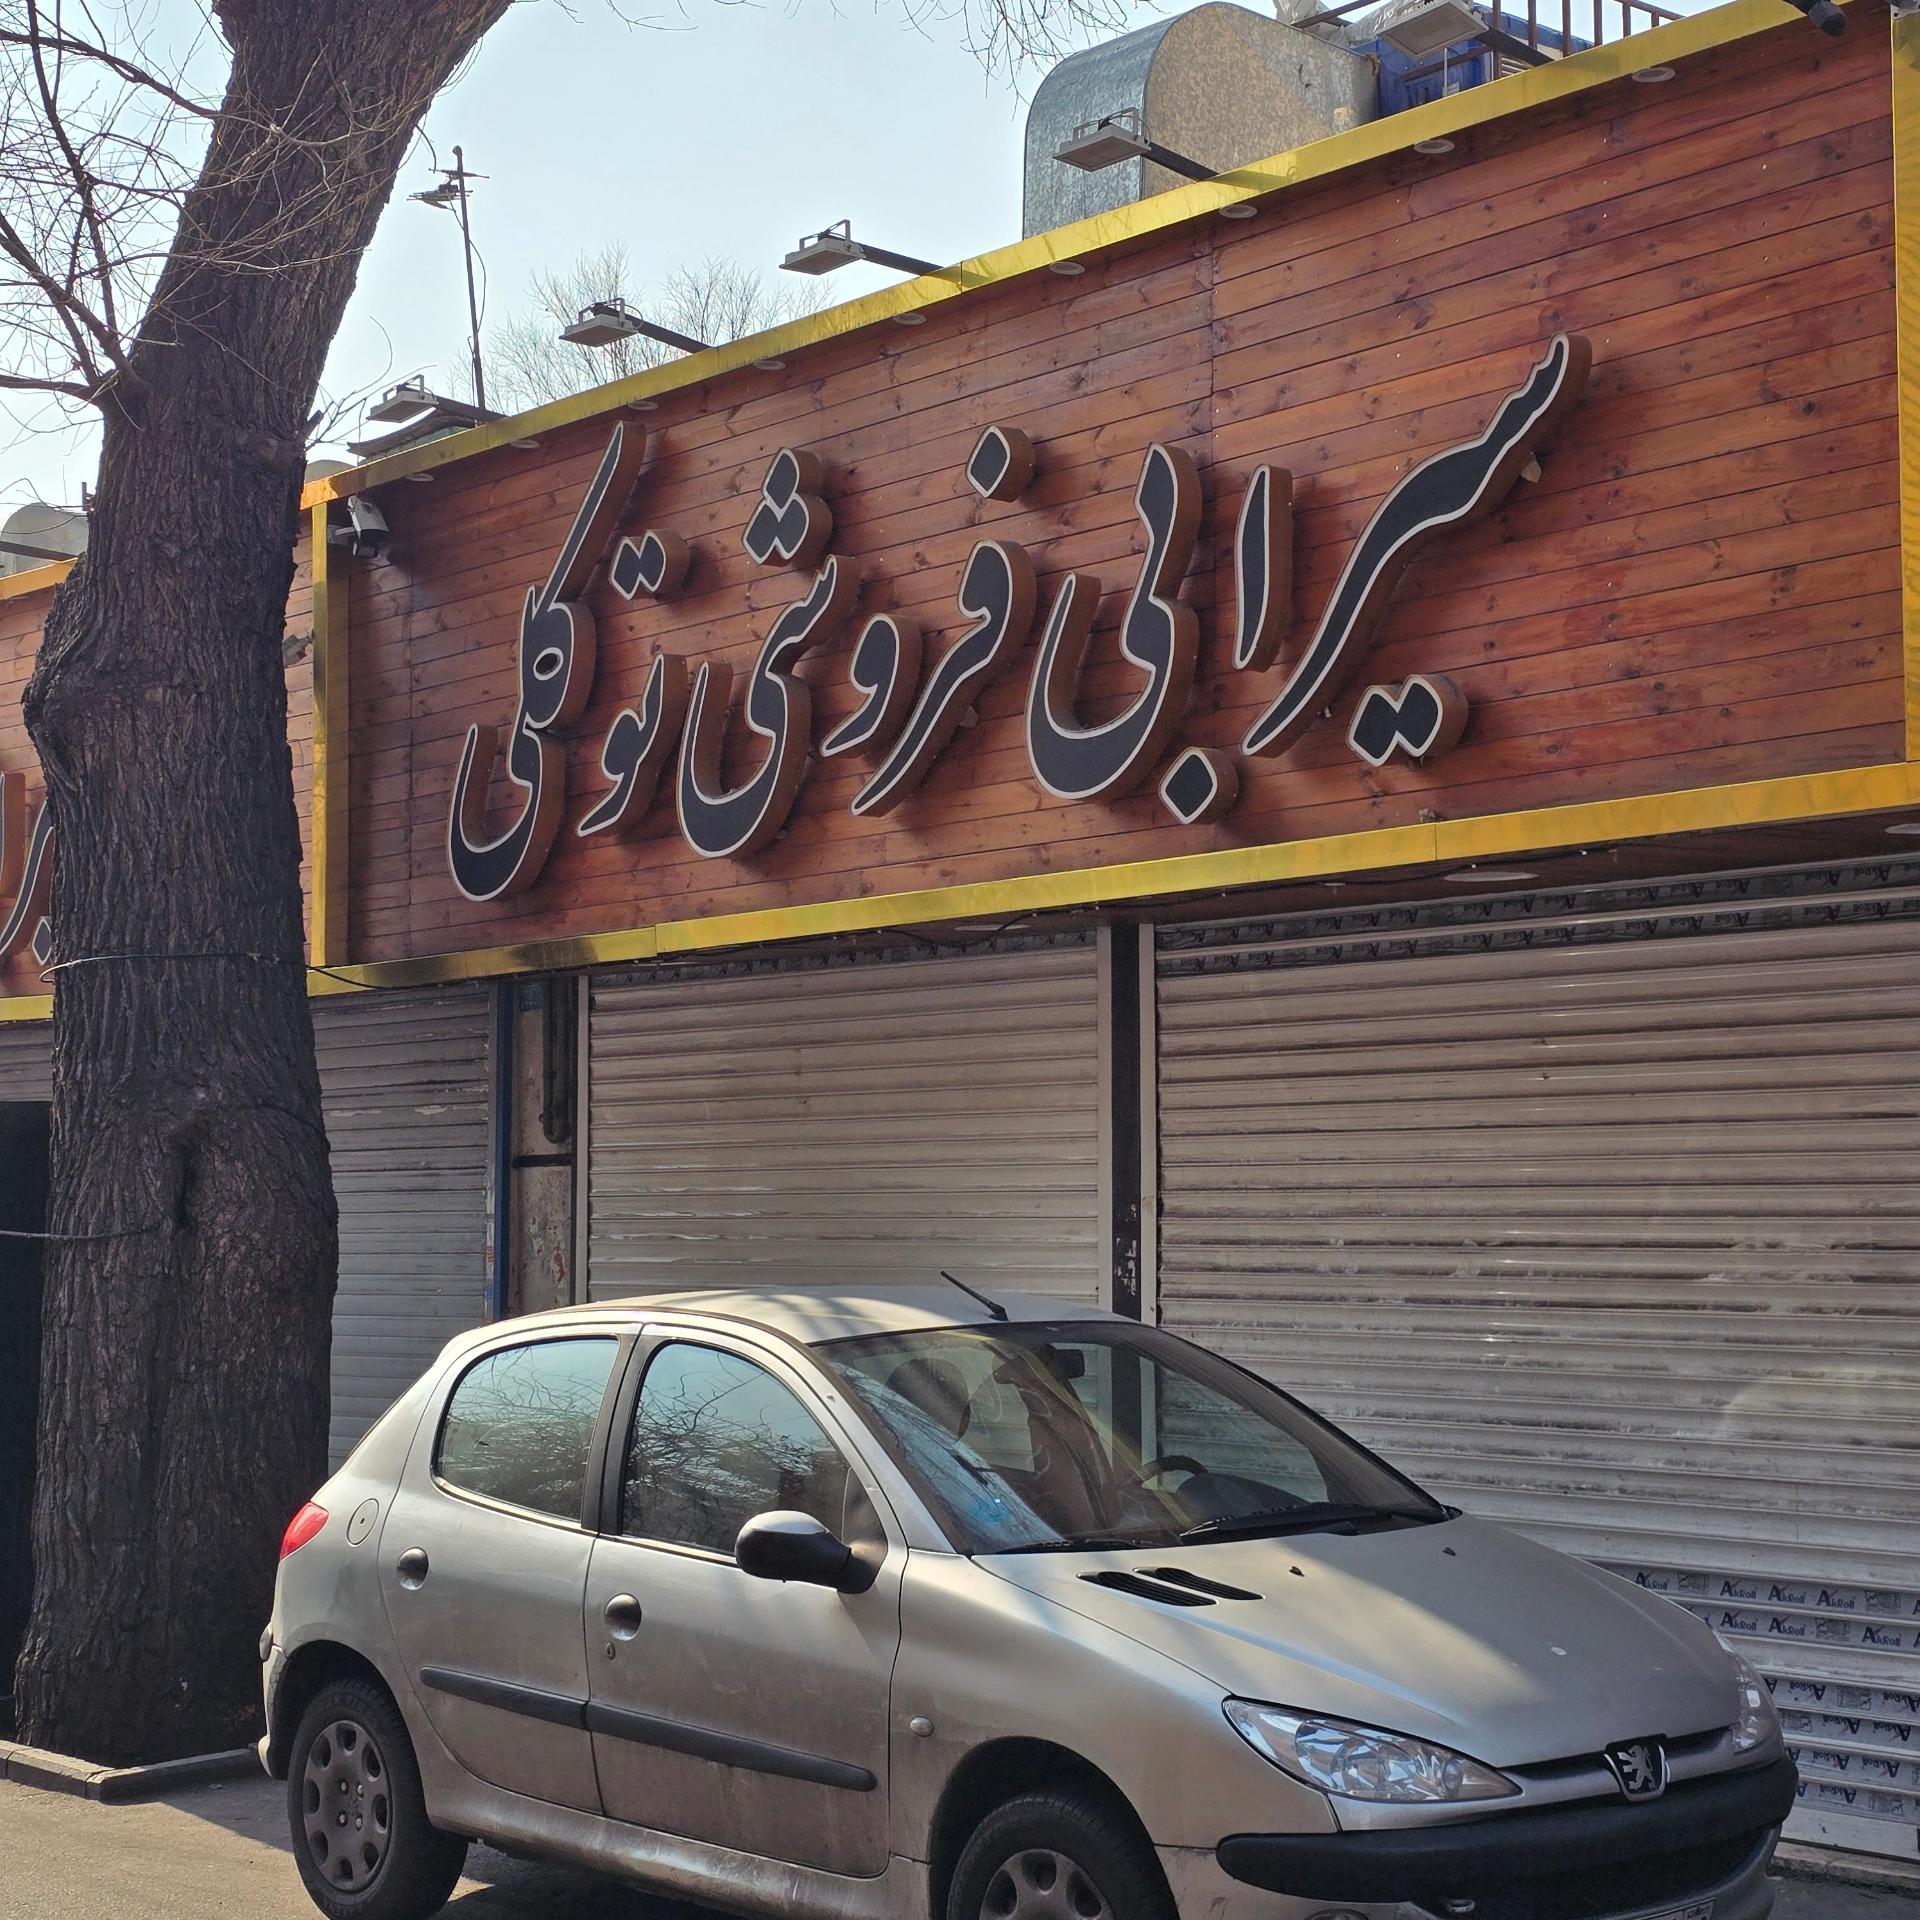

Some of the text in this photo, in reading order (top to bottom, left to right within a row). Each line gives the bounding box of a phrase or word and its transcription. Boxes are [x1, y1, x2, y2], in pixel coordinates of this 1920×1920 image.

[1027, 332, 1590, 826] سیرابی
[676, 424, 1036, 860] فروشی
[445, 418, 690, 903] توکلی
[1720, 1579, 1757, 1600] AkRoll
[1768, 1584, 1806, 1604] AkRoll
[1816, 1589, 1855, 1609] AkRoll
[1720, 1610, 1757, 1631] AkRoll
[1768, 1616, 1806, 1636] AkRoll
[1861, 1625, 1901, 1647] AkRoll
[1789, 1680, 1826, 1700] AkRoll
[1823, 1714, 1861, 1734] AkRoll
[1873, 1722, 1912, 1741] AkRoll
[1813, 1751, 1850, 1771] AkRoll
[1862, 1757, 1900, 1778] AkRoll
[1820, 1784, 1857, 1803] AkRoll
